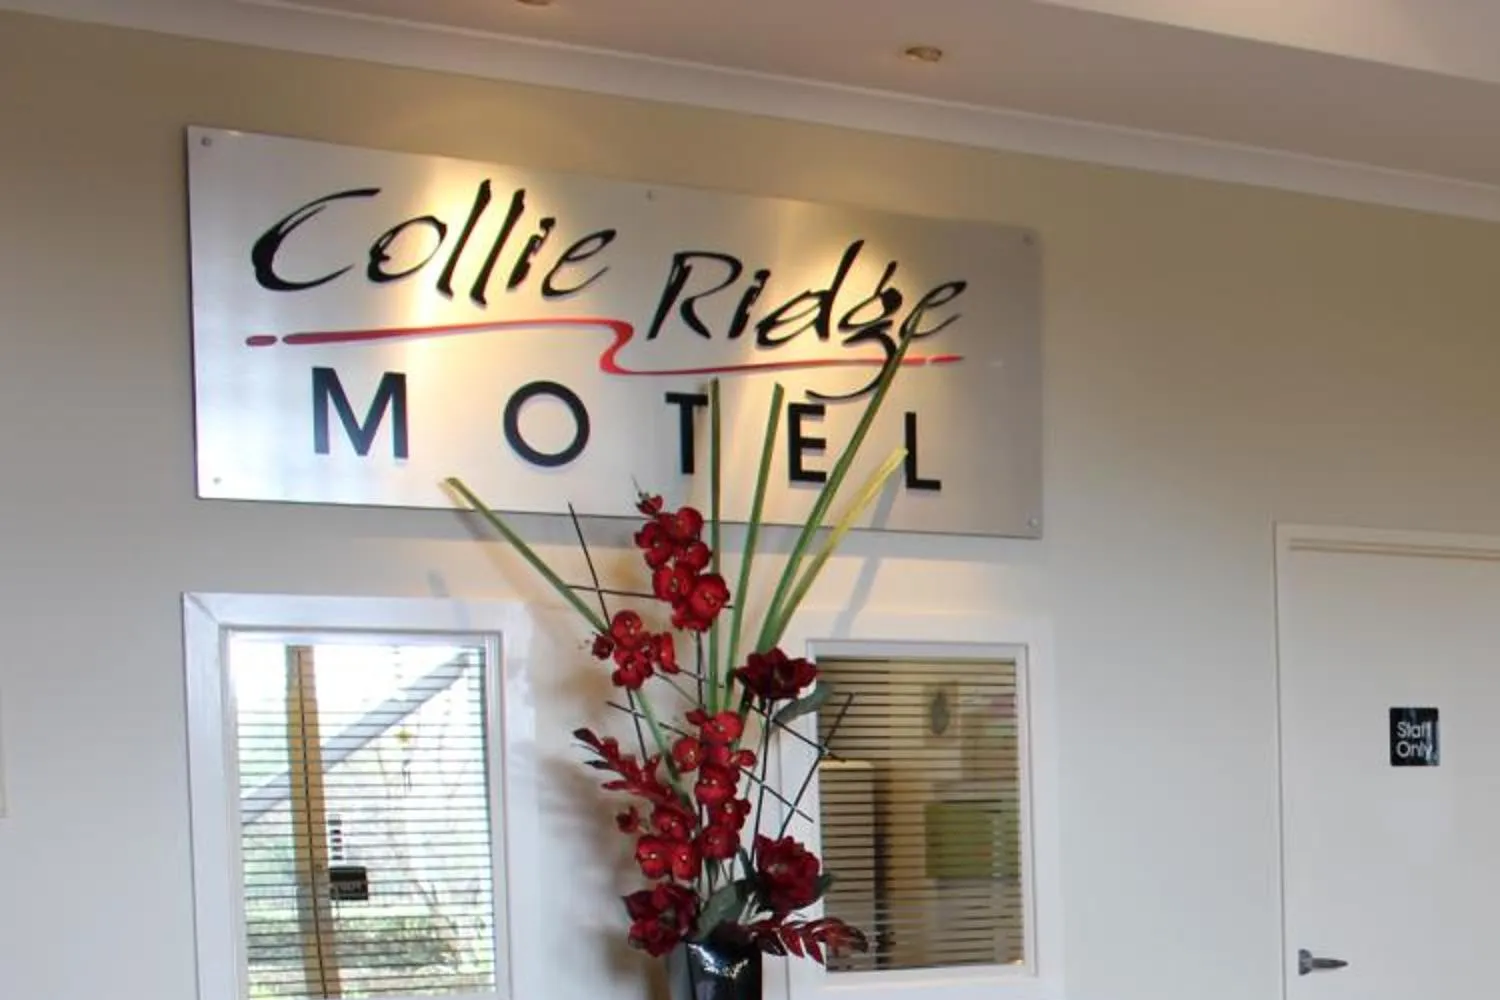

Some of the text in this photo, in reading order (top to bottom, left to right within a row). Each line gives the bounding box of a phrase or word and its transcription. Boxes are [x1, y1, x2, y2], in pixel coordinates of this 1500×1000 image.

[251, 178, 969, 400] Collie Ridge
[311, 366, 943, 492] MOTEL
[1396, 741, 1432, 761] Only
